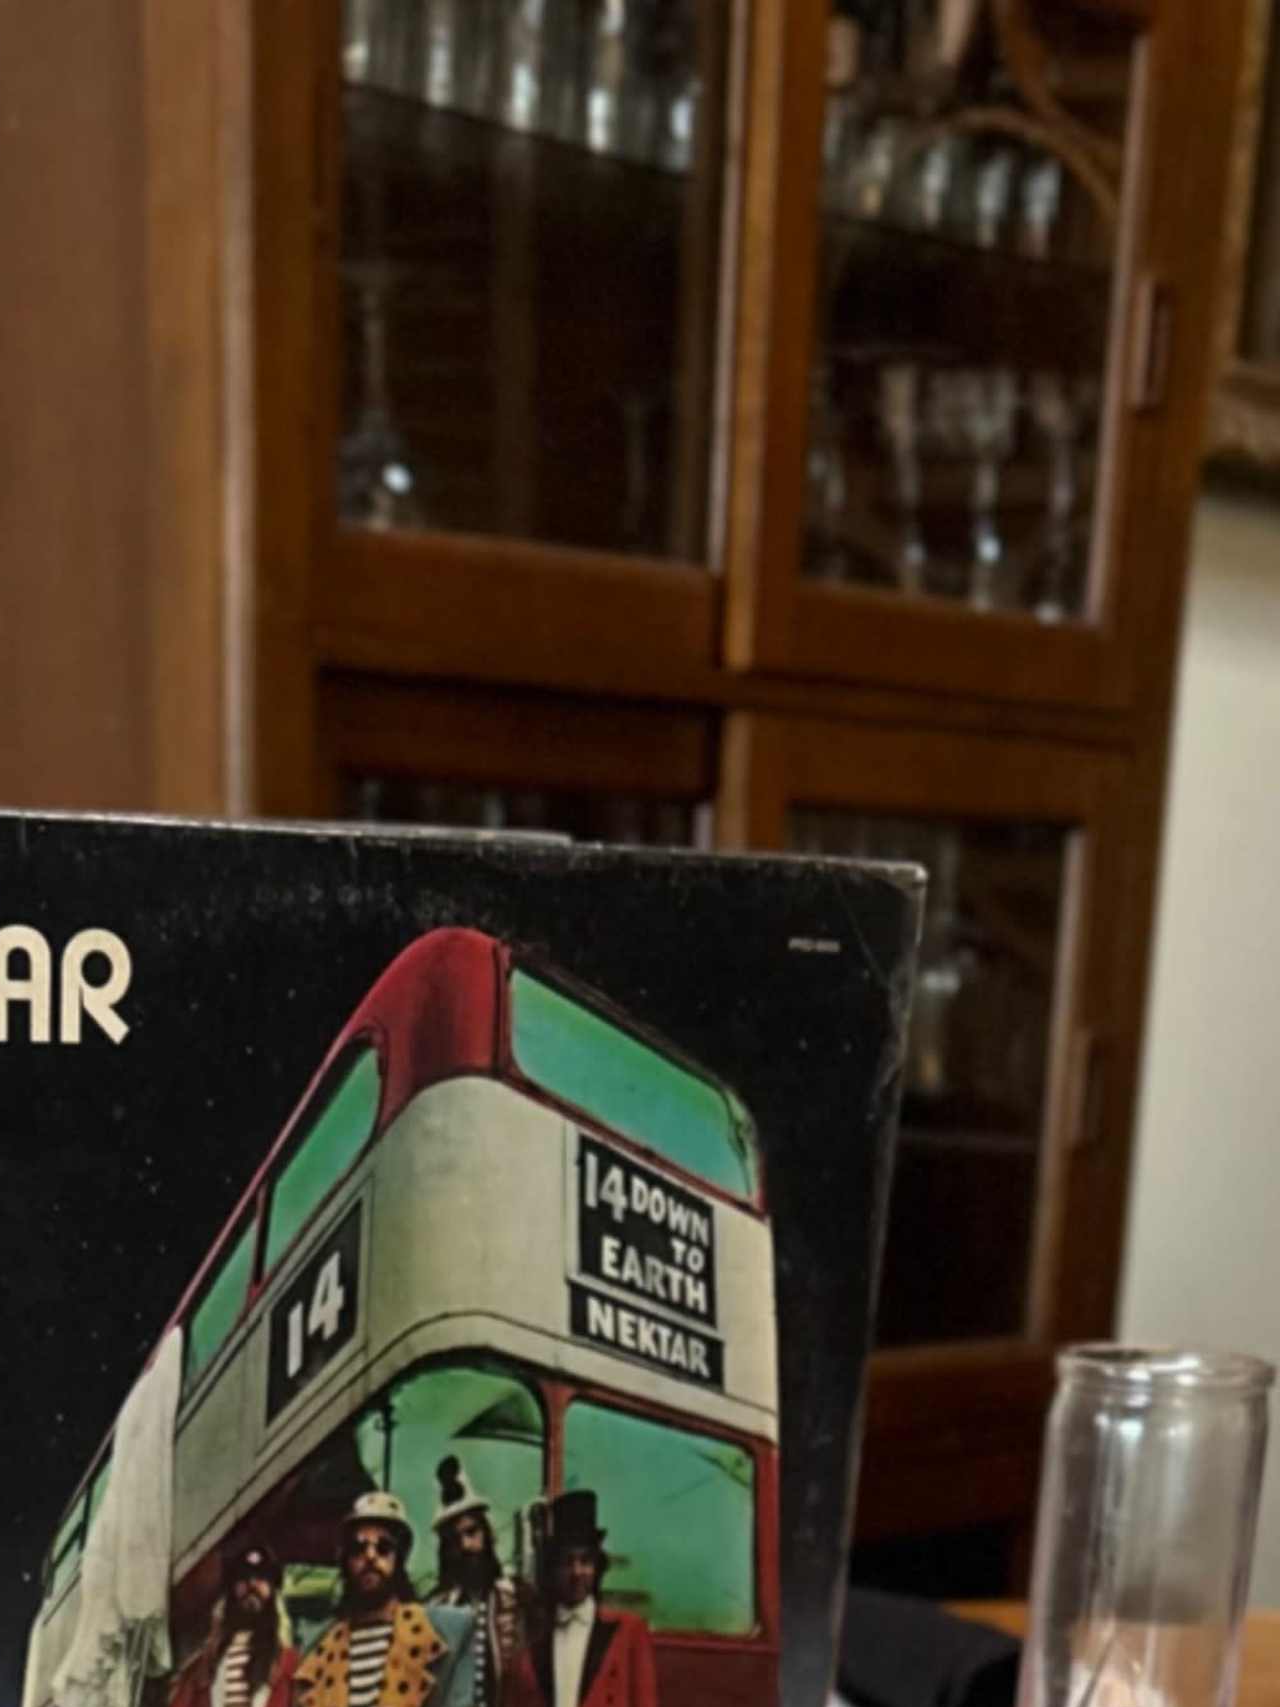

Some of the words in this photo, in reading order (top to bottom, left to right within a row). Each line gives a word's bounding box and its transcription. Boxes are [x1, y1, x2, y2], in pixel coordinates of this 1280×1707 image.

[585, 1151, 628, 1224] 14
[630, 1177, 710, 1246] DOWN
[601, 1235, 708, 1314] EARTH
[672, 1241, 704, 1272] TO
[287, 1250, 345, 1379] 14
[587, 1298, 711, 1378] NEKTAR
